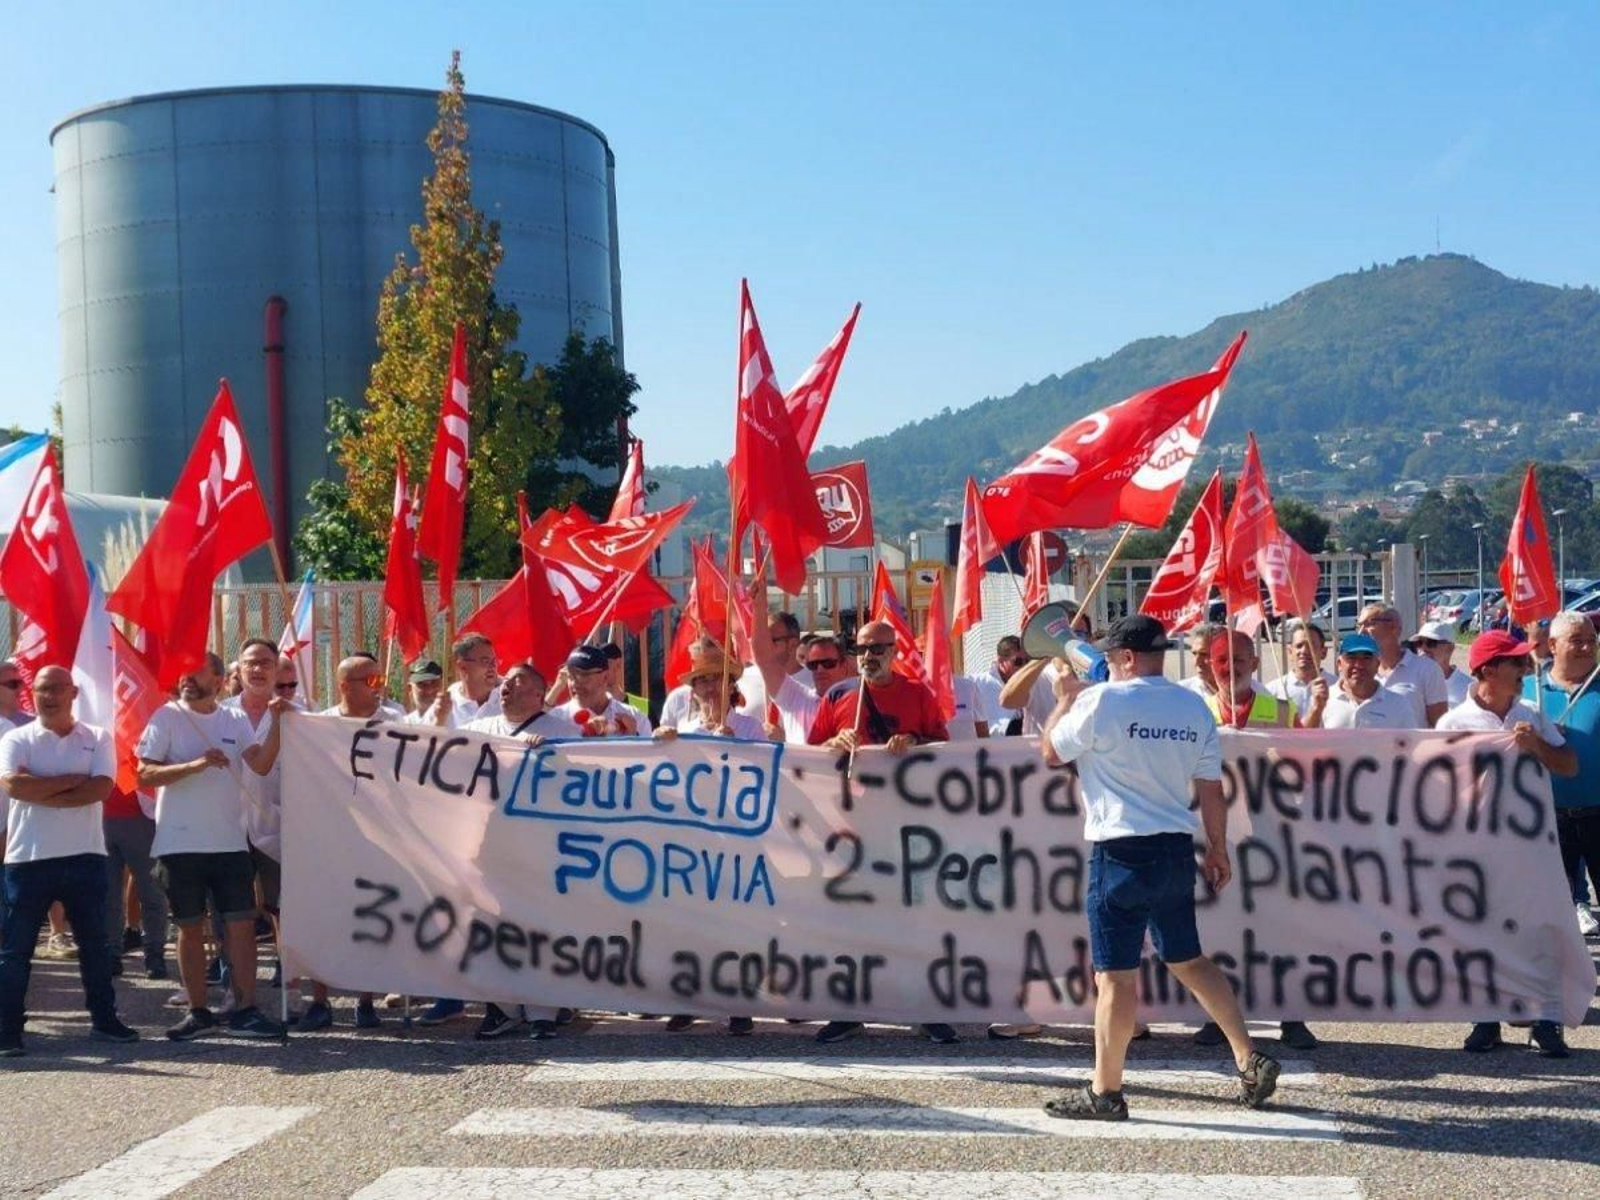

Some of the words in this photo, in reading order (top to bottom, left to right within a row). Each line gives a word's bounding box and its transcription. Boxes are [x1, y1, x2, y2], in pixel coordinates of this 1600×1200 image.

[351, 720, 500, 800] ÉTICA
[1128, 722, 1198, 743] faurecia
[458, 919, 646, 989] persoal
[927, 932, 990, 1009] da
